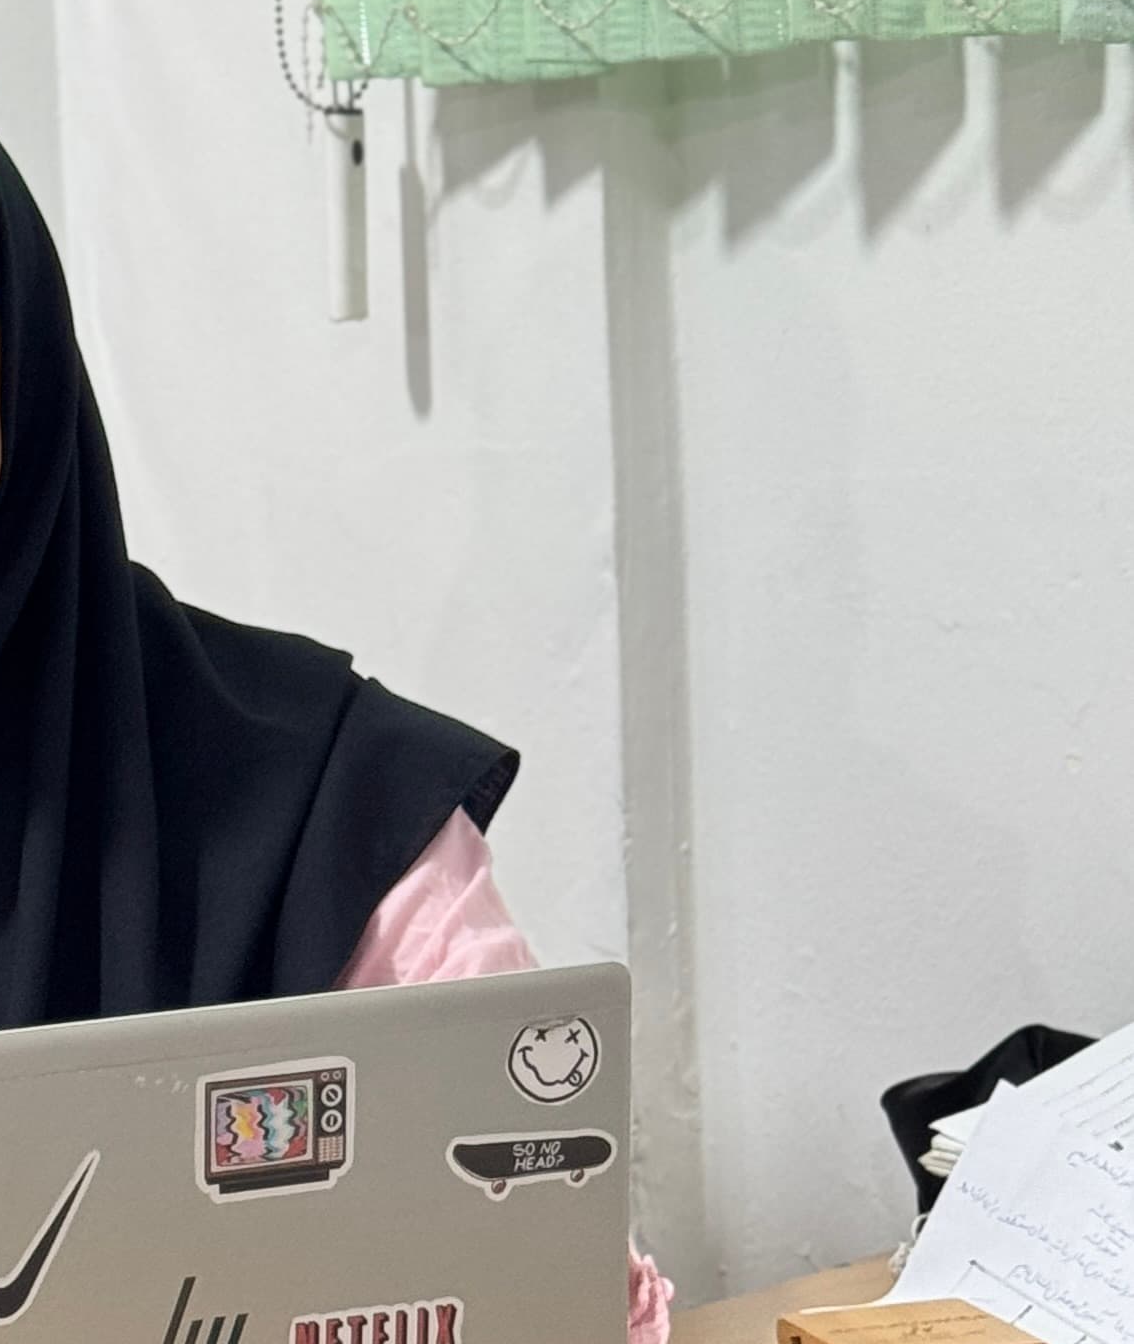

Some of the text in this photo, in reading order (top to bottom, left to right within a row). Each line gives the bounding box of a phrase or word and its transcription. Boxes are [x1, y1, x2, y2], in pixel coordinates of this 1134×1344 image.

[513, 1140, 562, 1157] SO NO
[513, 1155, 566, 1173] HEAD?
